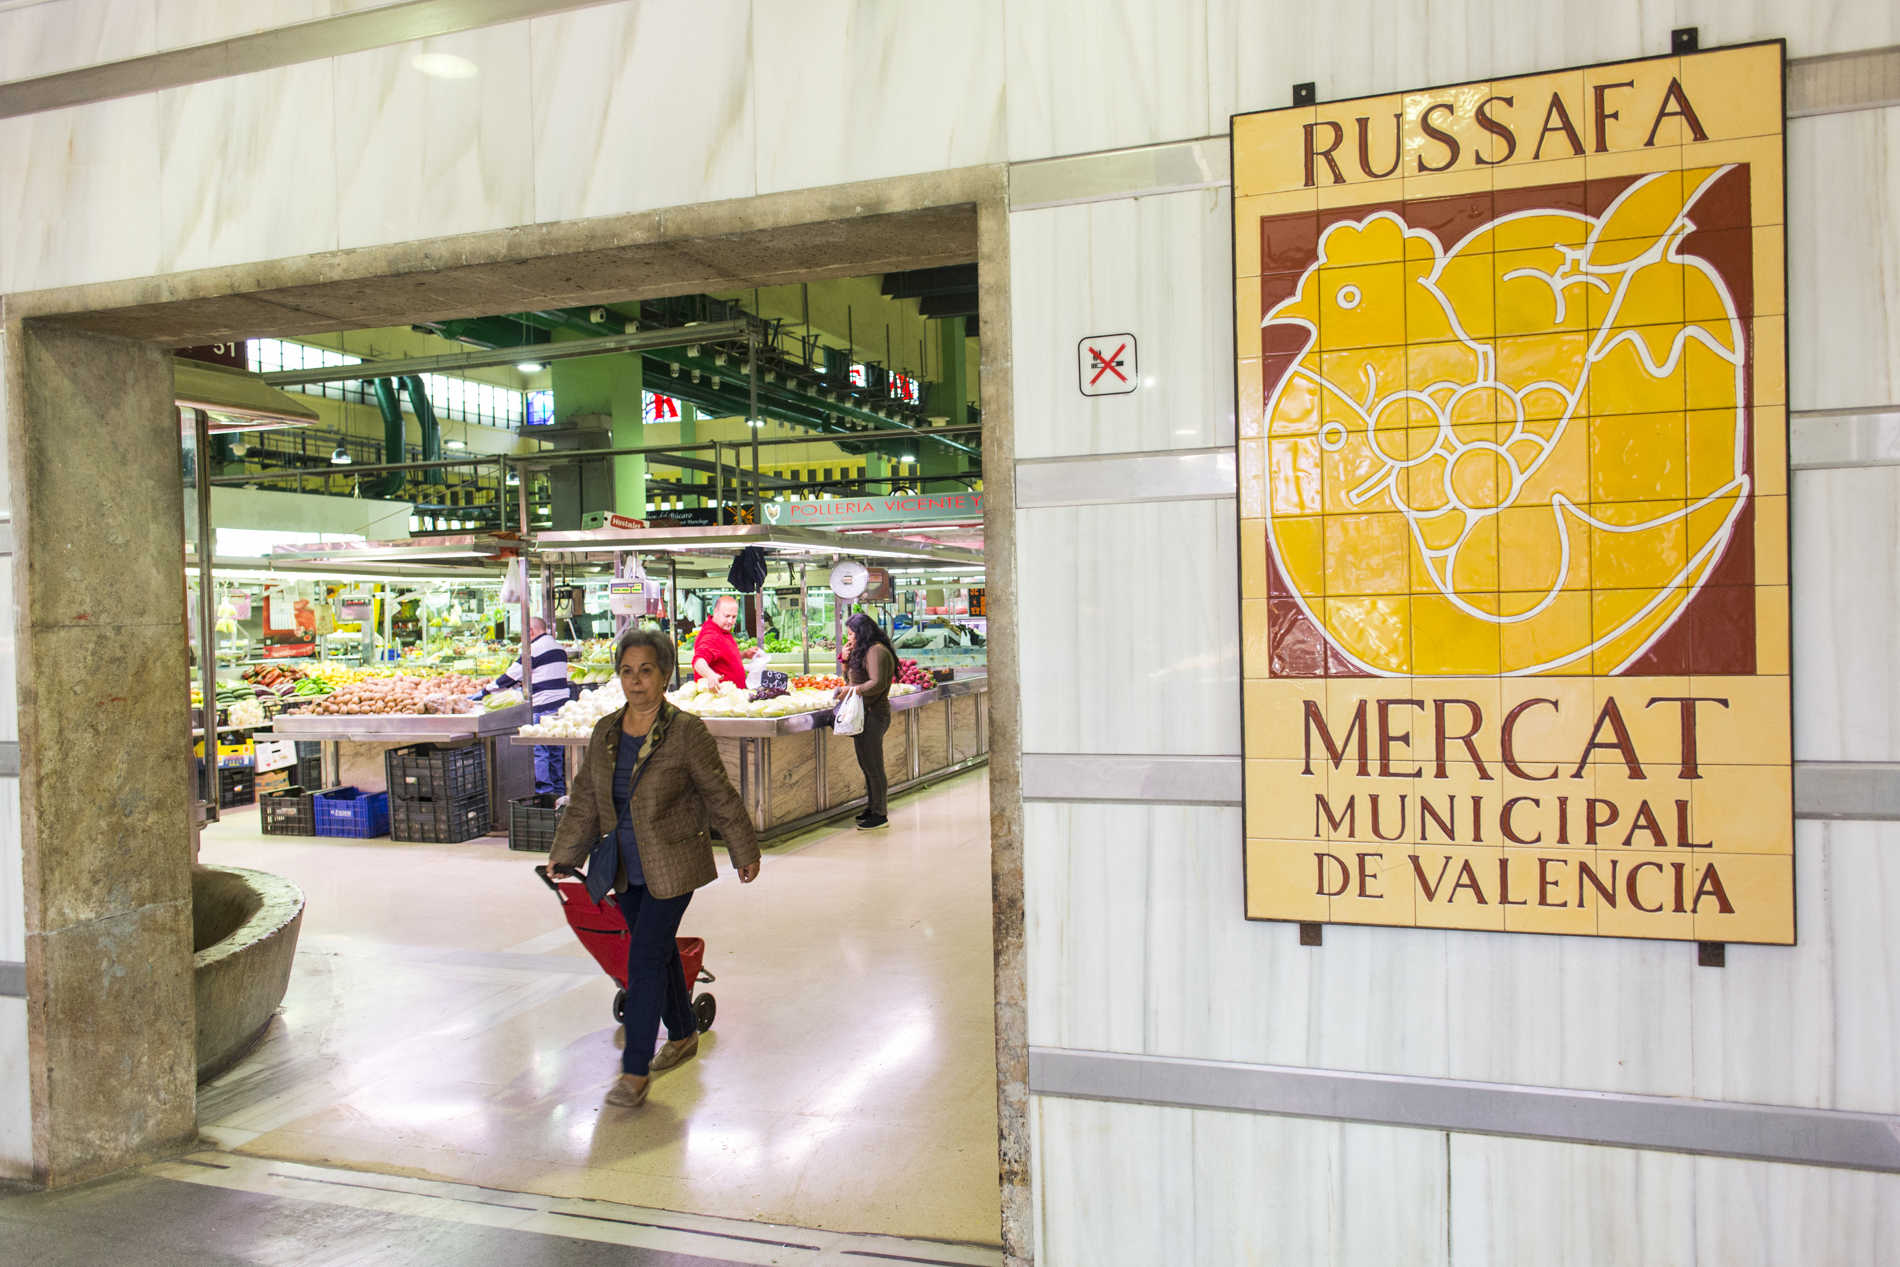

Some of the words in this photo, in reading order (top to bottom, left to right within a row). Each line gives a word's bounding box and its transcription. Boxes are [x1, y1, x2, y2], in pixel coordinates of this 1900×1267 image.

[1302, 76, 1710, 188] RUSSAFA
[884, 494, 965, 513] VICENTE
[1301, 696, 1731, 781] MERCAT
[1314, 793, 1713, 849] MUNICIPAL
[1313, 852, 1384, 899] DE
[1407, 853, 1736, 915] VALENCIA
